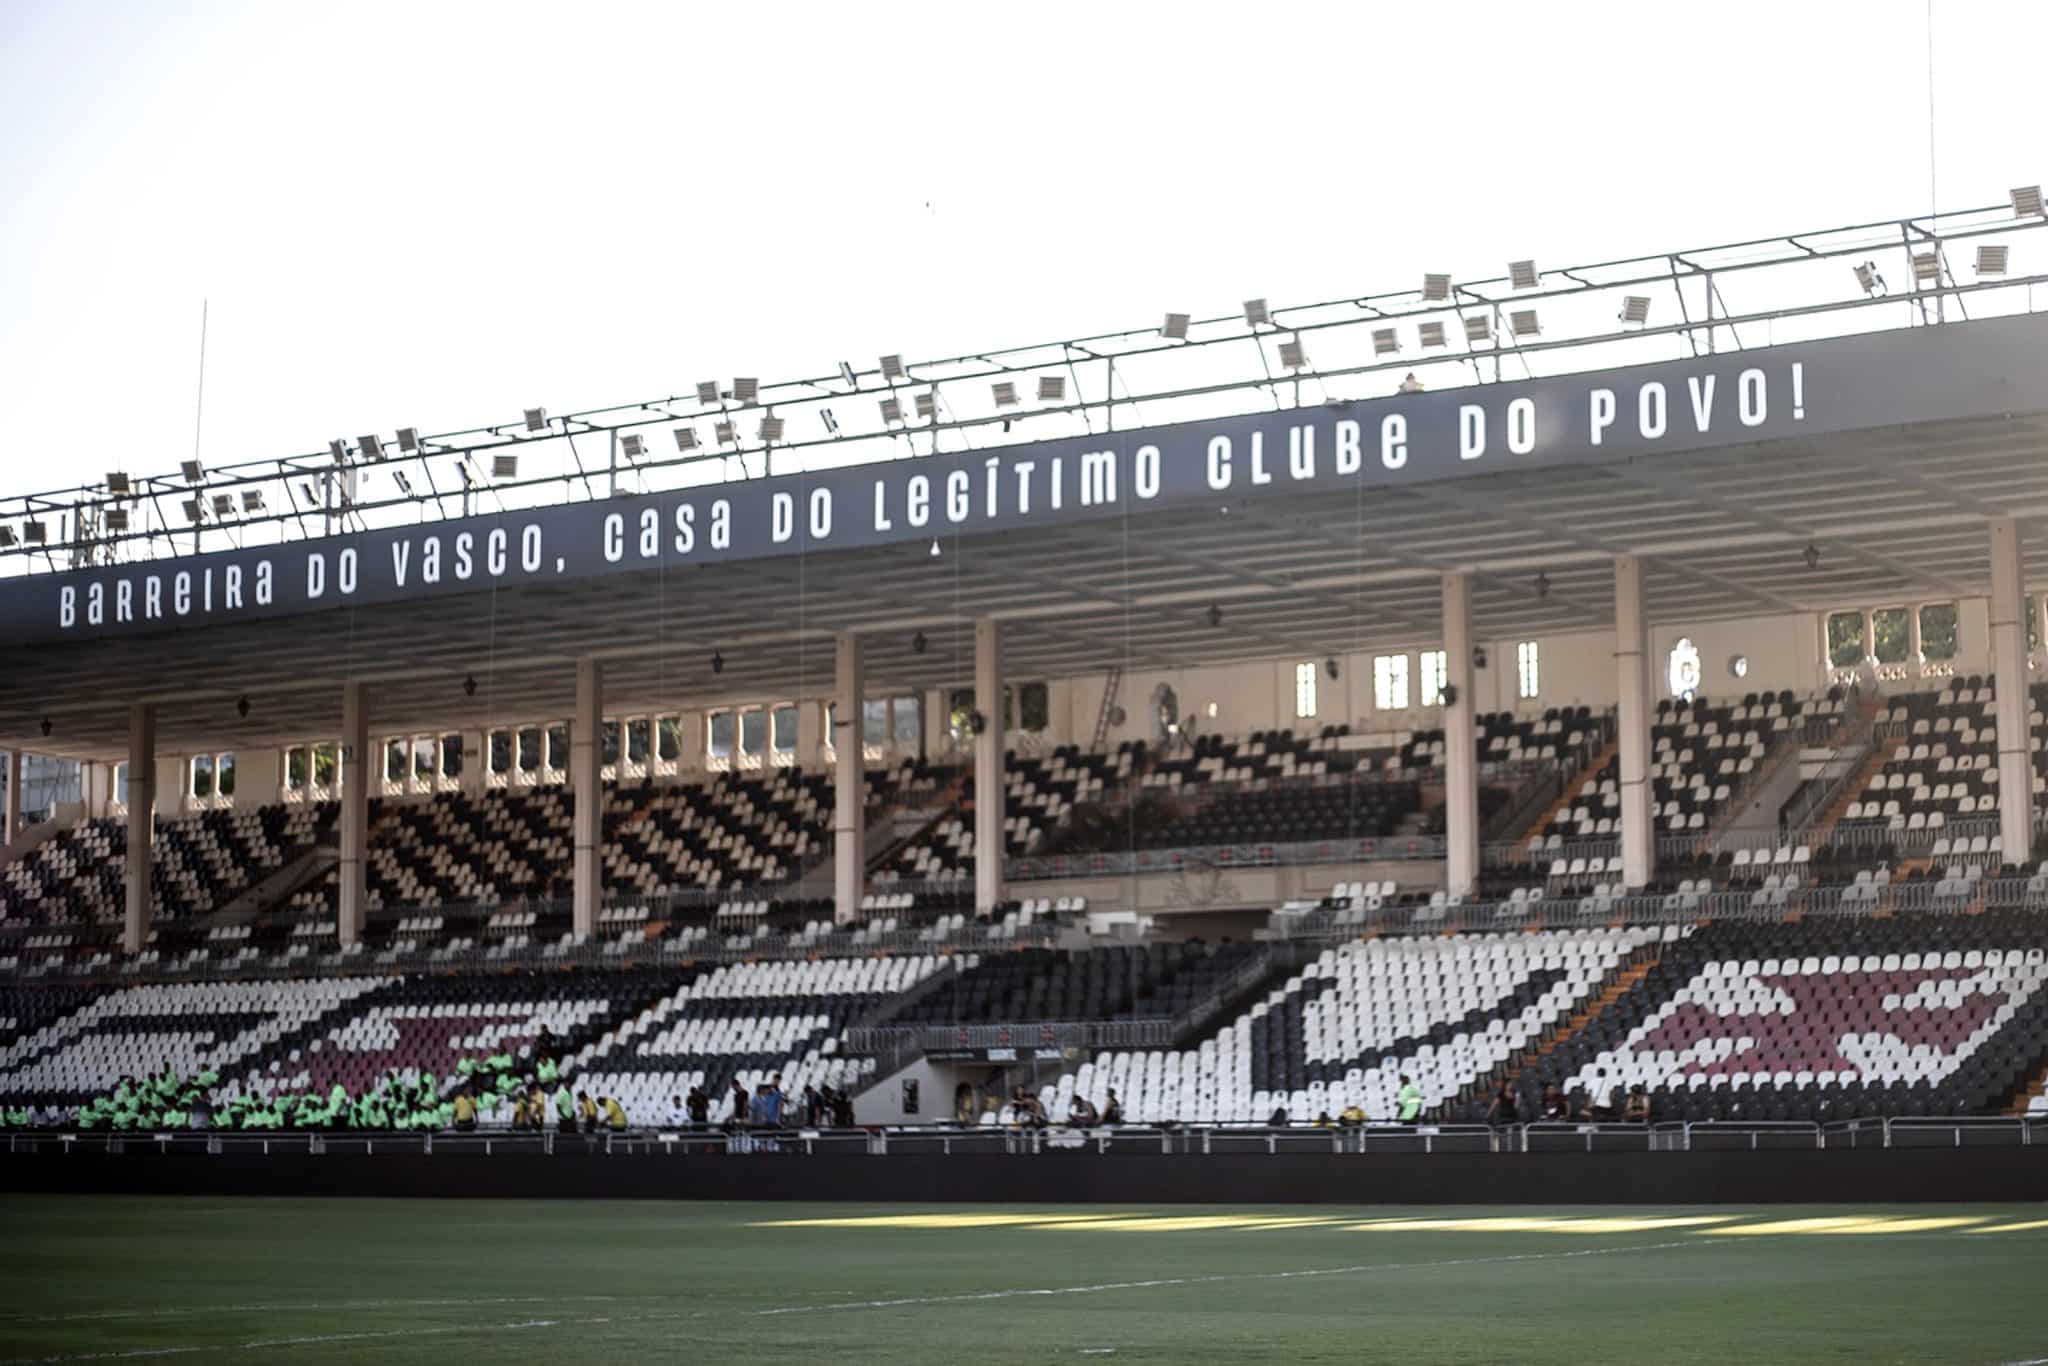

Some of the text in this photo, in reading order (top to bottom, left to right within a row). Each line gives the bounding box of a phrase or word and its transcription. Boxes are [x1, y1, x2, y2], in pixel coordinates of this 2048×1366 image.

[307, 547, 358, 599] DO
[772, 487, 833, 543] DO
[1459, 397, 1536, 461] DO
[1590, 362, 1805, 446] POVO!
